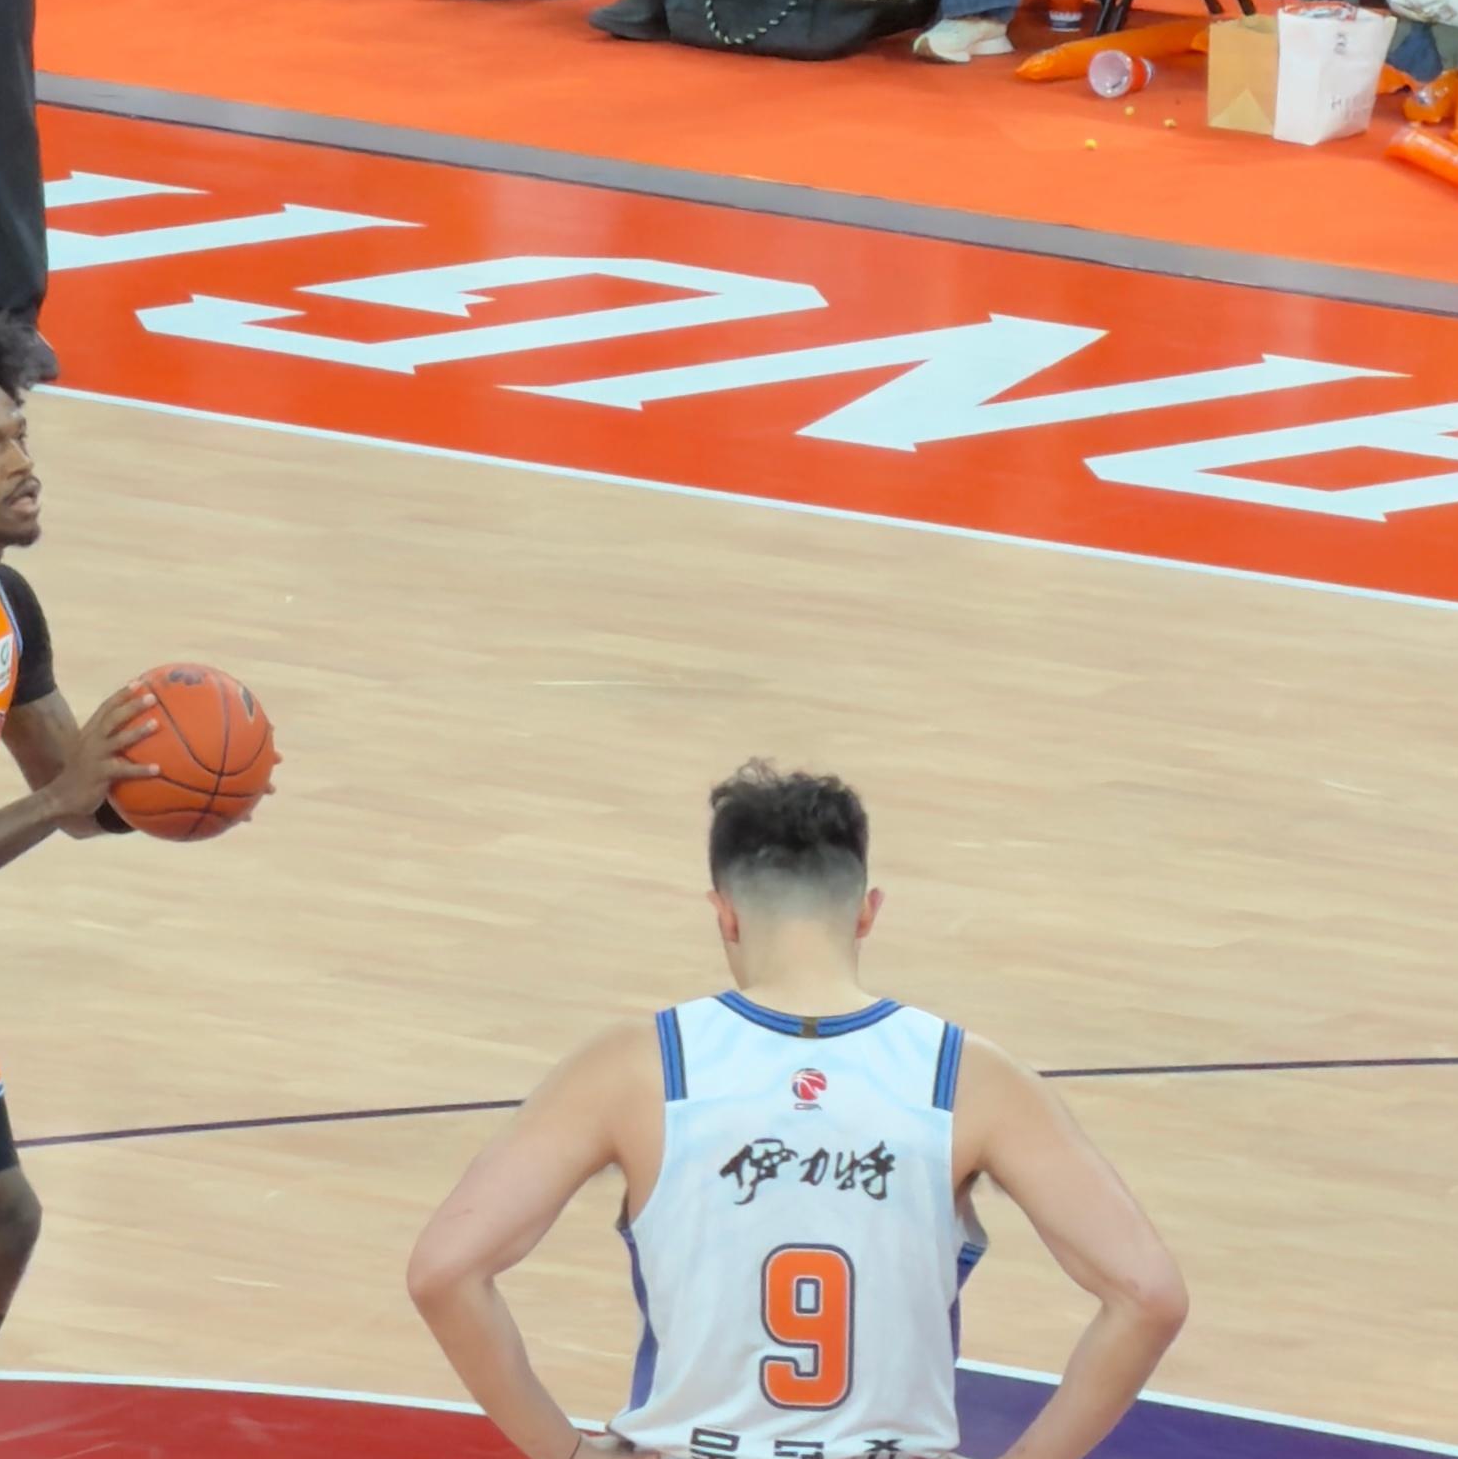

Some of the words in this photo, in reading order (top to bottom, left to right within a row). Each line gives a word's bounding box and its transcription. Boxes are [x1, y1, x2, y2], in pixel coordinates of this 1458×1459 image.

[718, 1137, 897, 1206] 伊力特
[759, 1242, 856, 1410] 9
